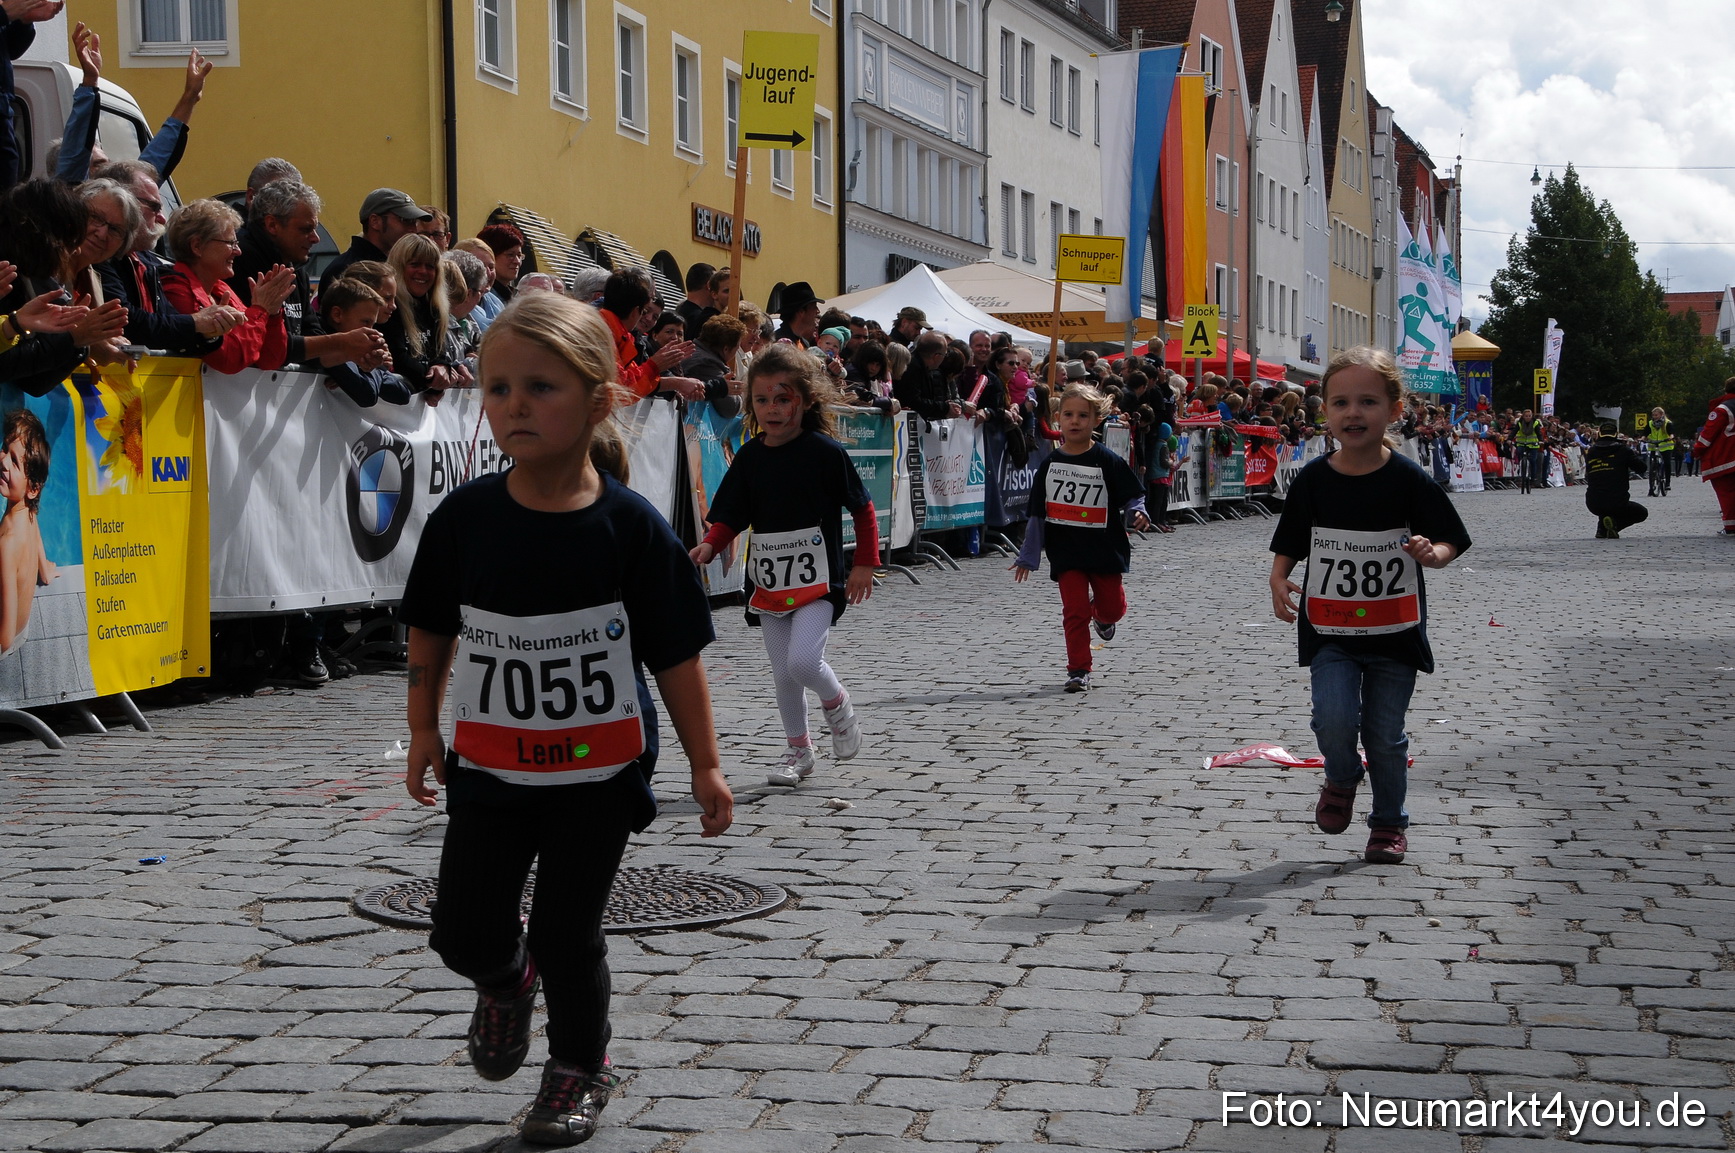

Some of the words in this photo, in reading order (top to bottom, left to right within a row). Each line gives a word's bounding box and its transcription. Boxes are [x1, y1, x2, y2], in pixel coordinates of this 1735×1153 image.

[745, 62, 815, 84] Jugend-
[763, 86, 796, 104] lauf
[696, 206, 762, 254] BELACNTO
[1062, 248, 1119, 261] Schnupper-
[1080, 262, 1099, 272] lauf
[1187, 306, 1215, 316] Block
[1189, 320, 1210, 346] A
[1414, 381, 1434, 389] 6352
[1538, 376, 1548, 388] B
[1638, 418, 1644, 426] C
[429, 440, 476, 495] BMW
[1049, 468, 1070, 476] PARTL
[1071, 472, 1102, 480] Neumarkt
[1053, 479, 1104, 506] 7377
[90, 518, 125, 534] Pflaster
[92, 542, 156, 562] Außenplatten
[761, 539, 808, 551] Neumarkt
[1313, 538, 1342, 551] PARTL
[1344, 541, 1398, 552] Neumarkt
[95, 570, 137, 587] Palisaden
[1320, 557, 1406, 598] 7382
[96, 597, 126, 614] Stufen
[97, 619, 169, 641] Gartenmauern
[461, 624, 504, 649] PARTL
[508, 628, 599, 651] Neumarkt
[469, 650, 616, 721] 7055
[623, 703, 634, 714] W
[517, 737, 573, 765] Leni
